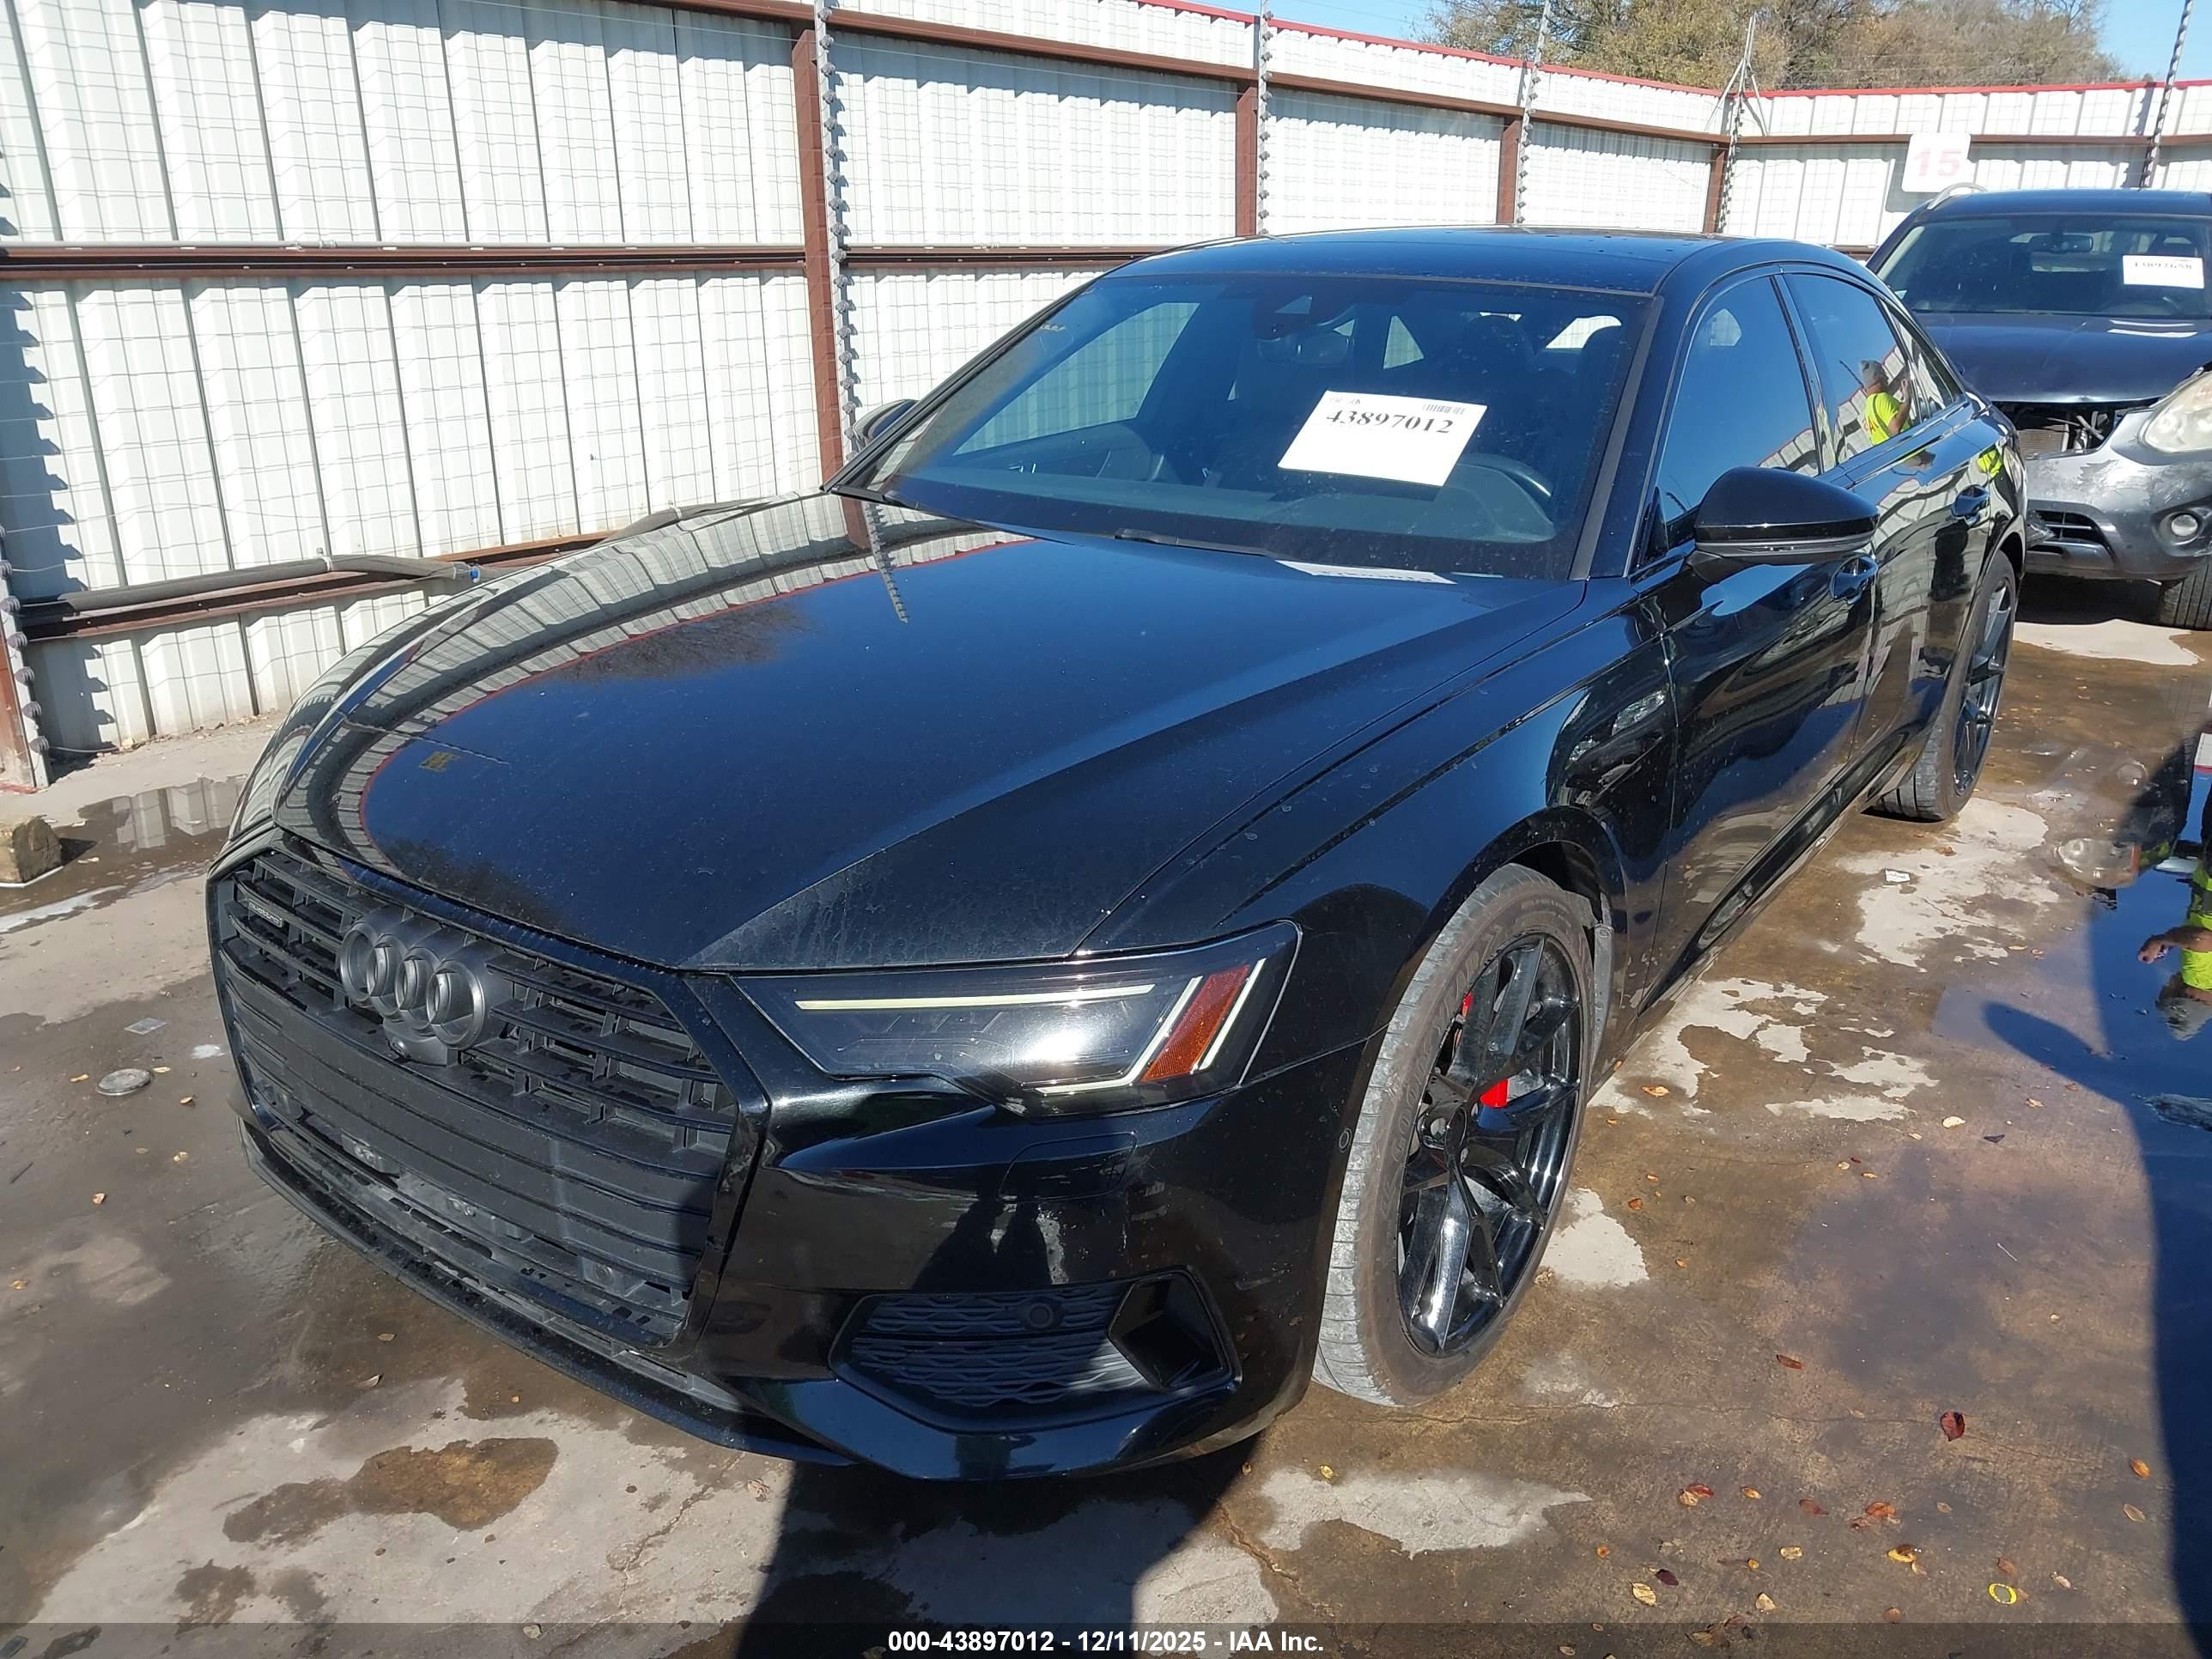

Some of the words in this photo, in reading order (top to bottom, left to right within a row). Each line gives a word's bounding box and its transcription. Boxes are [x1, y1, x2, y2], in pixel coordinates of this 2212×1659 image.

[1913, 149, 1963, 177] 15
[1326, 409, 1454, 434] 43897012
[248, 902, 280, 925] quattro
